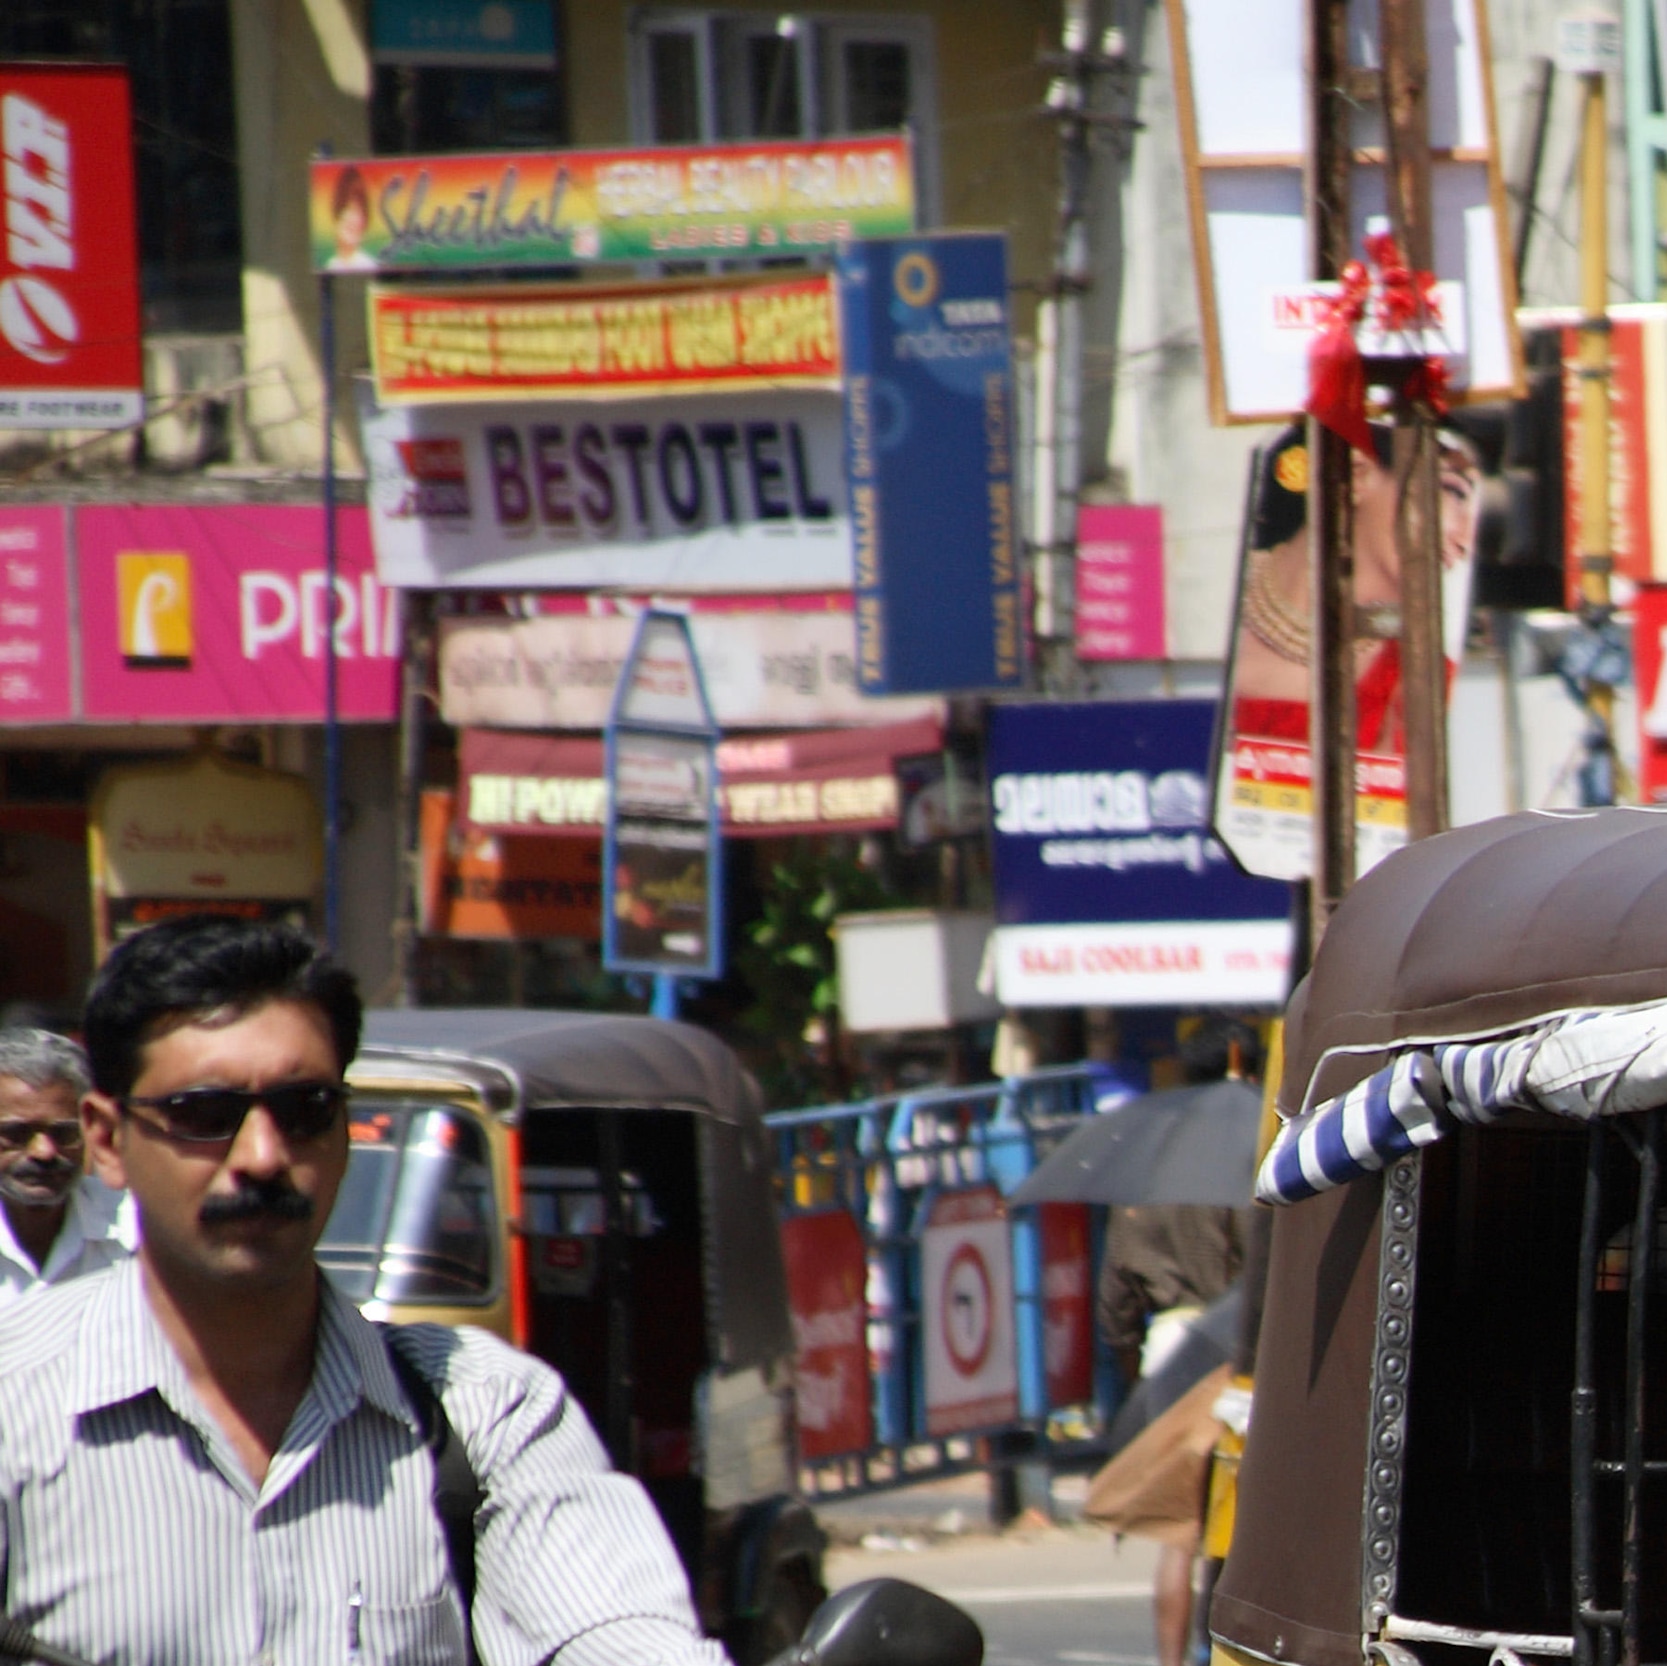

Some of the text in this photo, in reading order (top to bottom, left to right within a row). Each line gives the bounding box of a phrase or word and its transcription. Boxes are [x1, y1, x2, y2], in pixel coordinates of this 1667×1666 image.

[942, 299, 1001, 326] TATA
[483, 418, 833, 532] BESTOTEL
[852, 483, 880, 588] VALUE
[988, 480, 1014, 586] VALUE
